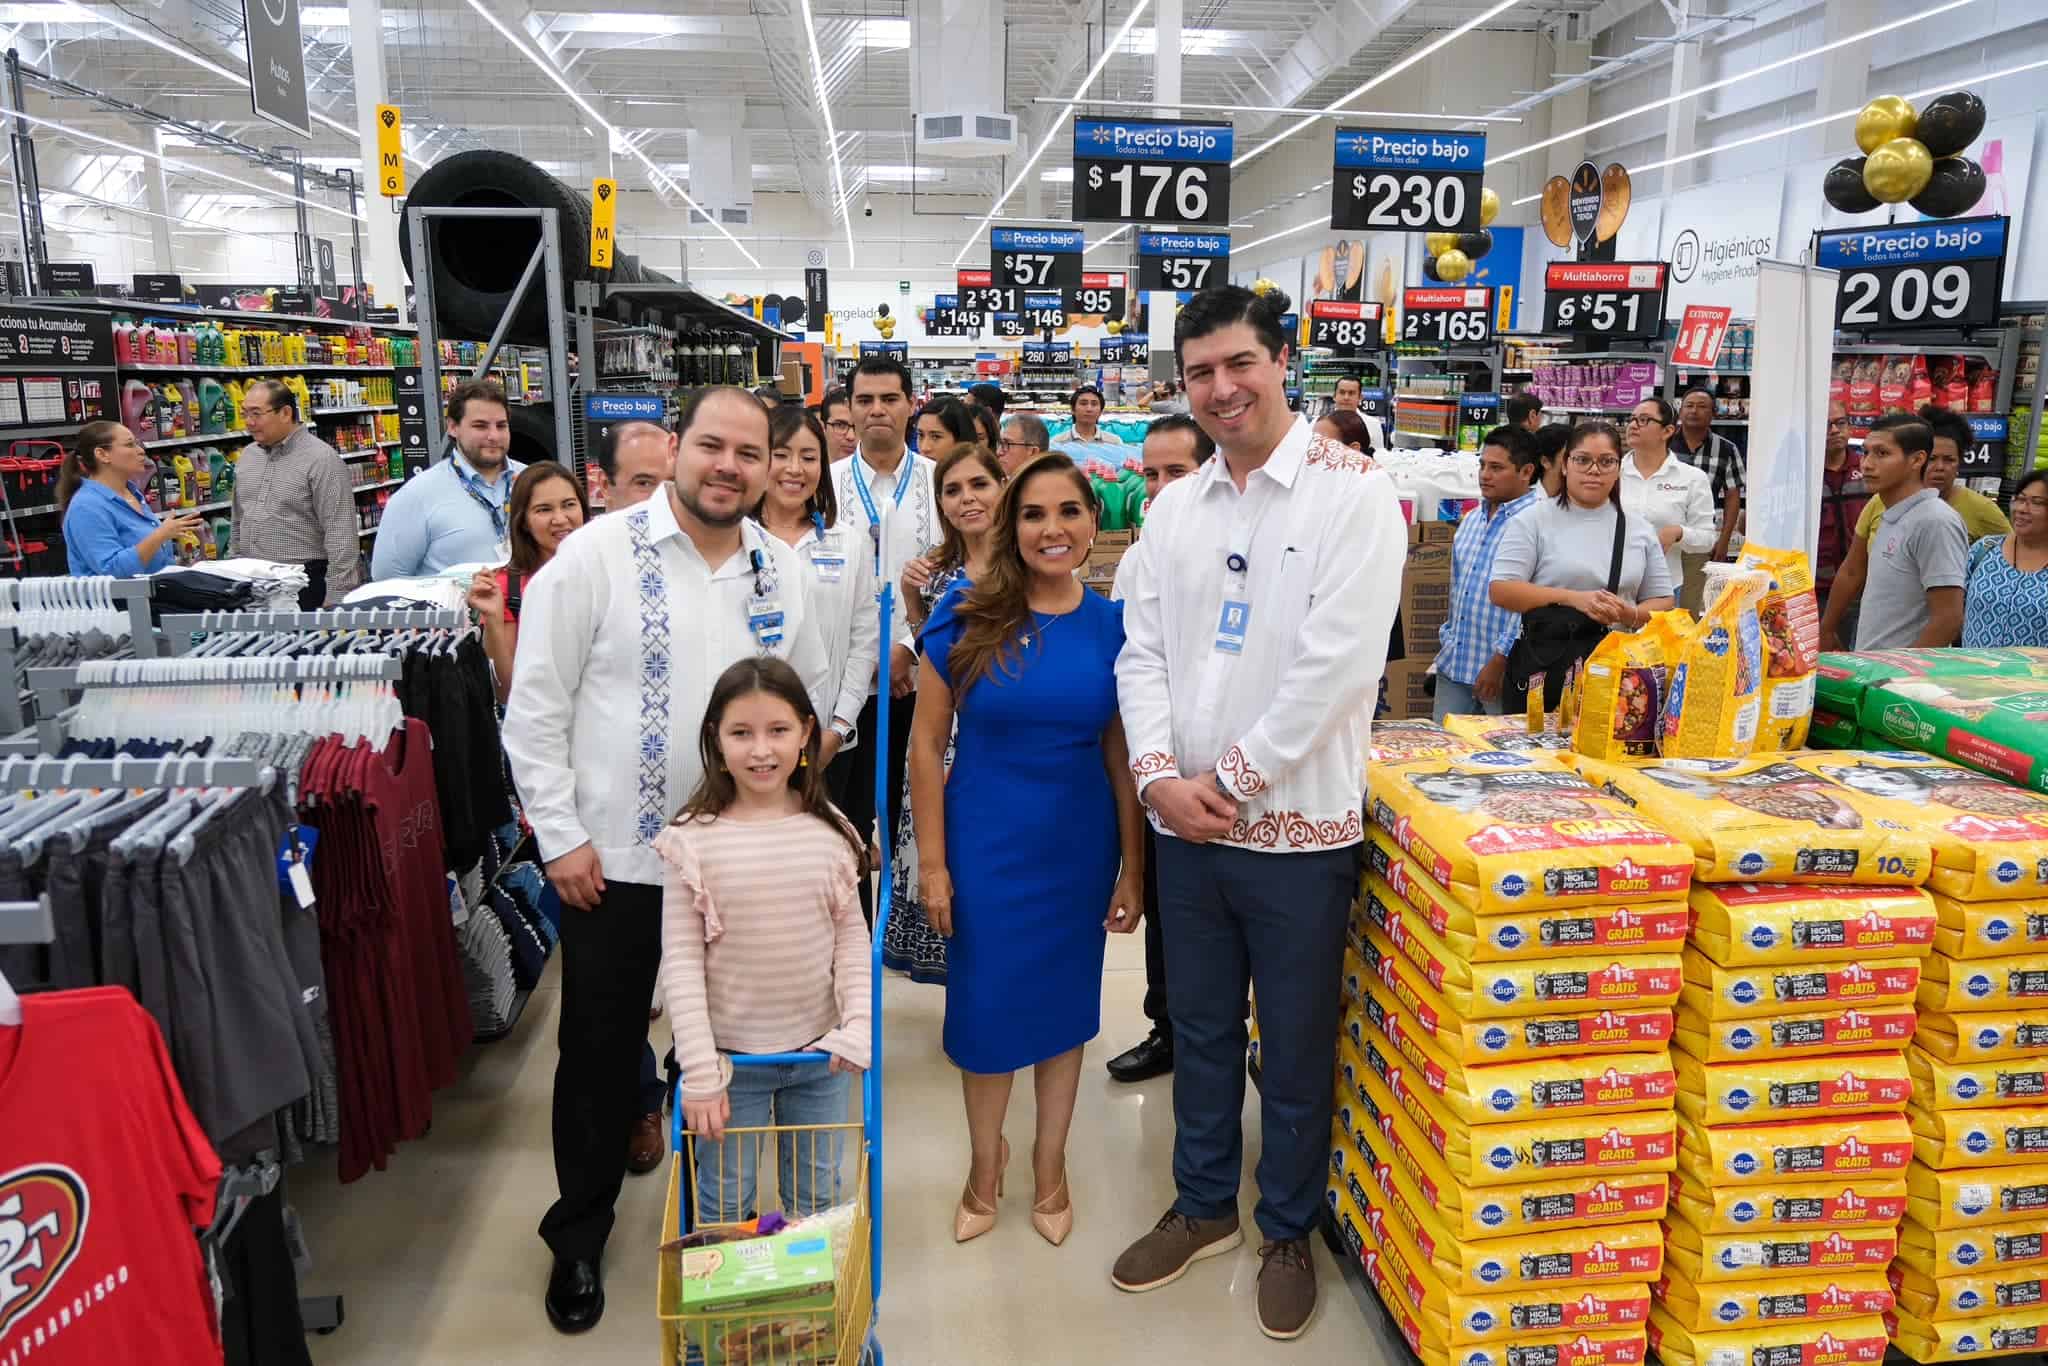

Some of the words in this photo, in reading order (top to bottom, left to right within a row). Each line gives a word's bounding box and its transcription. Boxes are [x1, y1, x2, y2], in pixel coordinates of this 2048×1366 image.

[1114, 127, 1172, 147] Precio
[1177, 130, 1216, 152] bajo
[1372, 136, 1427, 156] Precio
[1432, 138, 1469, 162] bajo
[384, 153, 398, 168] M
[387, 176, 397, 189] 6
[595, 228, 608, 240] M
[1014, 232, 1048, 244] Precio
[1051, 233, 1074, 246] bajo
[1863, 232, 1928, 253] Precio
[1936, 228, 1982, 252] bajo
[1161, 237, 1195, 248] Precio
[1197, 238, 1220, 251] bajo
[596, 250, 605, 262] 5
[1704, 236, 1770, 266] Higiénicos
[1004, 254, 1055, 285] $57
[1162, 258, 1211, 288] $57
[1562, 272, 1624, 281] Multiahorro
[967, 291, 976, 304] 2
[980, 289, 1015, 311] $31
[1075, 290, 1111, 312] $95
[1416, 294, 1461, 303] Multiahorro
[1025, 310, 1063, 326] $146
[1558, 297, 1576, 319] 6
[1581, 294, 1640, 332] $51
[1406, 316, 1418, 331] 2
[1422, 311, 1486, 340] $165
[1558, 319, 1573, 328] por
[1318, 322, 1328, 335] 2
[1330, 321, 1366, 345] $83
[19, 334, 29, 353] 2
[61, 336, 70, 354] 3
[602, 401, 633, 411] Precio
[635, 402, 656, 413] bajo
[1984, 420, 2002, 433] bajo
[1817, 856, 1840, 864] HIGH
[1610, 880, 1649, 891] GRATIS
[1607, 928, 1644, 940] GRATIS
[1857, 931, 1894, 944] GRATIS
[1600, 982, 1637, 994] GRATIS
[1793, 980, 1813, 988] HIGH
[1840, 982, 1876, 994] GRATIS
[1544, 1026, 1565, 1034] HIGH
[1592, 1030, 1629, 1041] GRATIS
[1790, 1027, 1810, 1035] HIGH
[1836, 1028, 1872, 1040] GRATIS
[1597, 1088, 1634, 1100] GRATIS
[1832, 1092, 1869, 1103] GRATIS
[1404, 1094, 1432, 1136] GRATIS
[1550, 1145, 1570, 1154] HIGH
[1599, 1149, 1635, 1161] GRATIS
[1835, 1157, 1871, 1168] GRATIS
[1392, 1193, 1419, 1241] GRATIS
[1383, 1237, 1411, 1286] GRATIS
[1584, 1261, 1619, 1273] GRATIS
[22, 1264, 129, 1356] FRANCISCO
